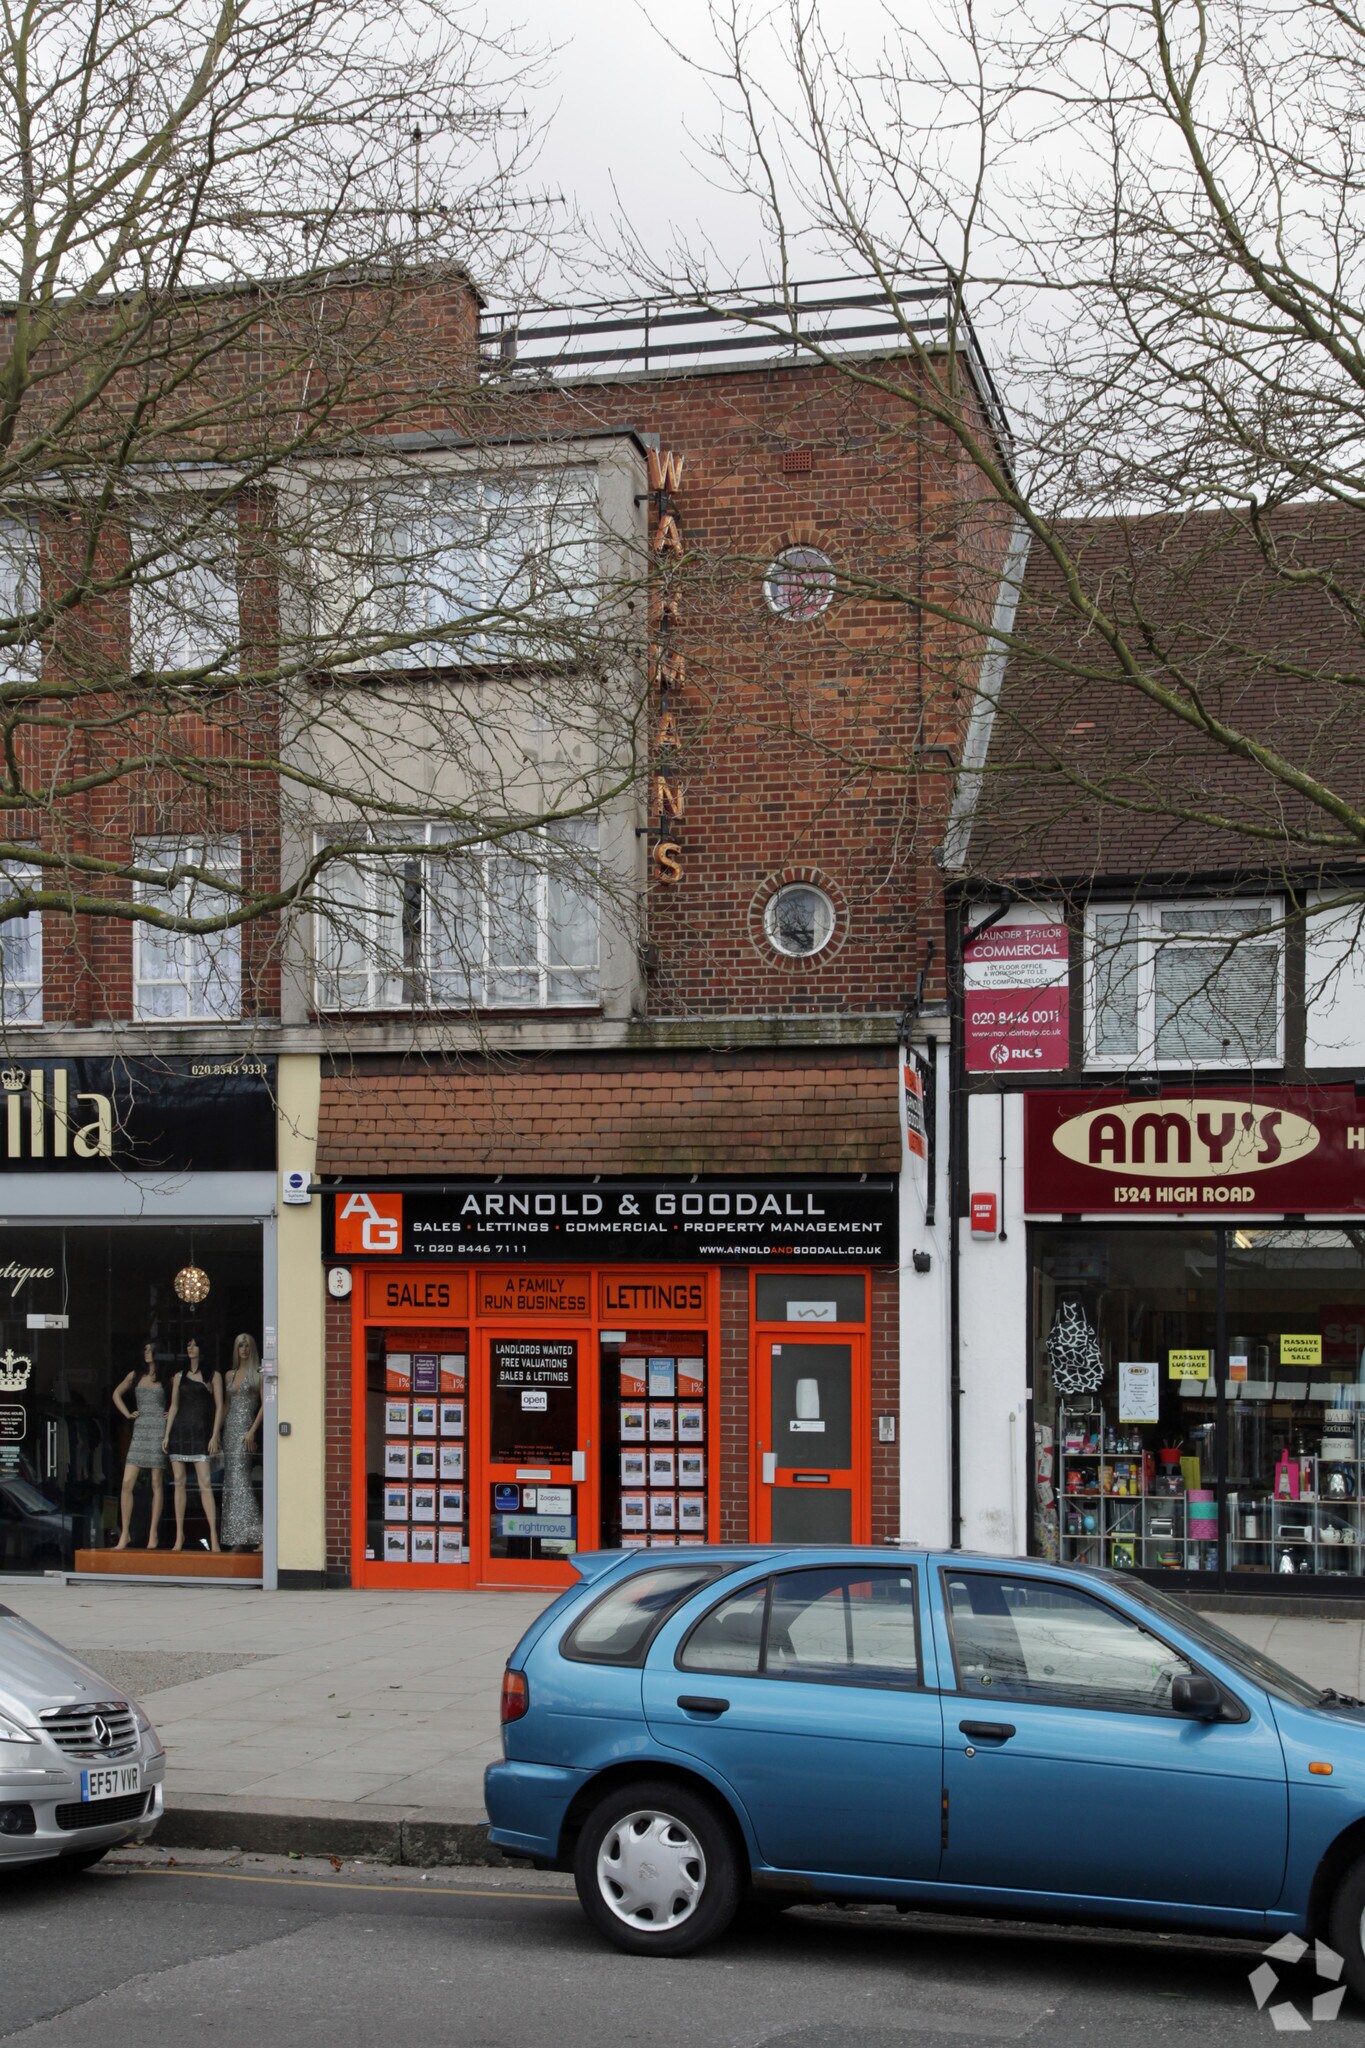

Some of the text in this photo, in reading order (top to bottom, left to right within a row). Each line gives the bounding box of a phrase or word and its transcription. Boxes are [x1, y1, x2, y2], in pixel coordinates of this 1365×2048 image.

[1025, 928, 1062, 941] TAYLOR
[973, 943, 1060, 957] COMMERCIAL
[972, 1012, 996, 1025] 020
[1032, 1010, 1059, 1023] 0011
[1012, 1048, 1043, 1058] RICS
[1088, 1111, 1283, 1164] AMY'S
[1114, 1186, 1256, 1203] 1324 HIGH ROAD
[460, 1193, 825, 1215] ARNOLD & GOODALL
[413, 1222, 883, 1232] SALES LETTINGS COMMERCIAL PROPERTY MANAGEMENT
[429, 1244, 454, 1252] 020
[458, 1244, 491, 1252] 8446
[495, 1245, 527, 1253] 7111
[699, 1246, 882, 1254] WWW.ARNOLDANDGOODALL.CO.UK
[505, 1279, 565, 1293] A FAMILY
[386, 1283, 450, 1307] SALES
[606, 1285, 702, 1309] LETTINGS
[485, 1295, 586, 1310] RUN BUSINESS
[495, 1344, 573, 1355] LANDLORDS WANTED
[501, 1357, 568, 1368] FREE VALUATIONS
[500, 1371, 568, 1381] SALES & LETTINGS
[398, 1378, 410, 1388] 1%
[452, 1378, 464, 1389] 1%
[633, 1382, 645, 1393] 1%
[691, 1382, 703, 1393] 1%
[523, 1396, 545, 1405] open
[519, 1522, 566, 1534] rightmove
[90, 1767, 138, 1796] EF57 VVR
